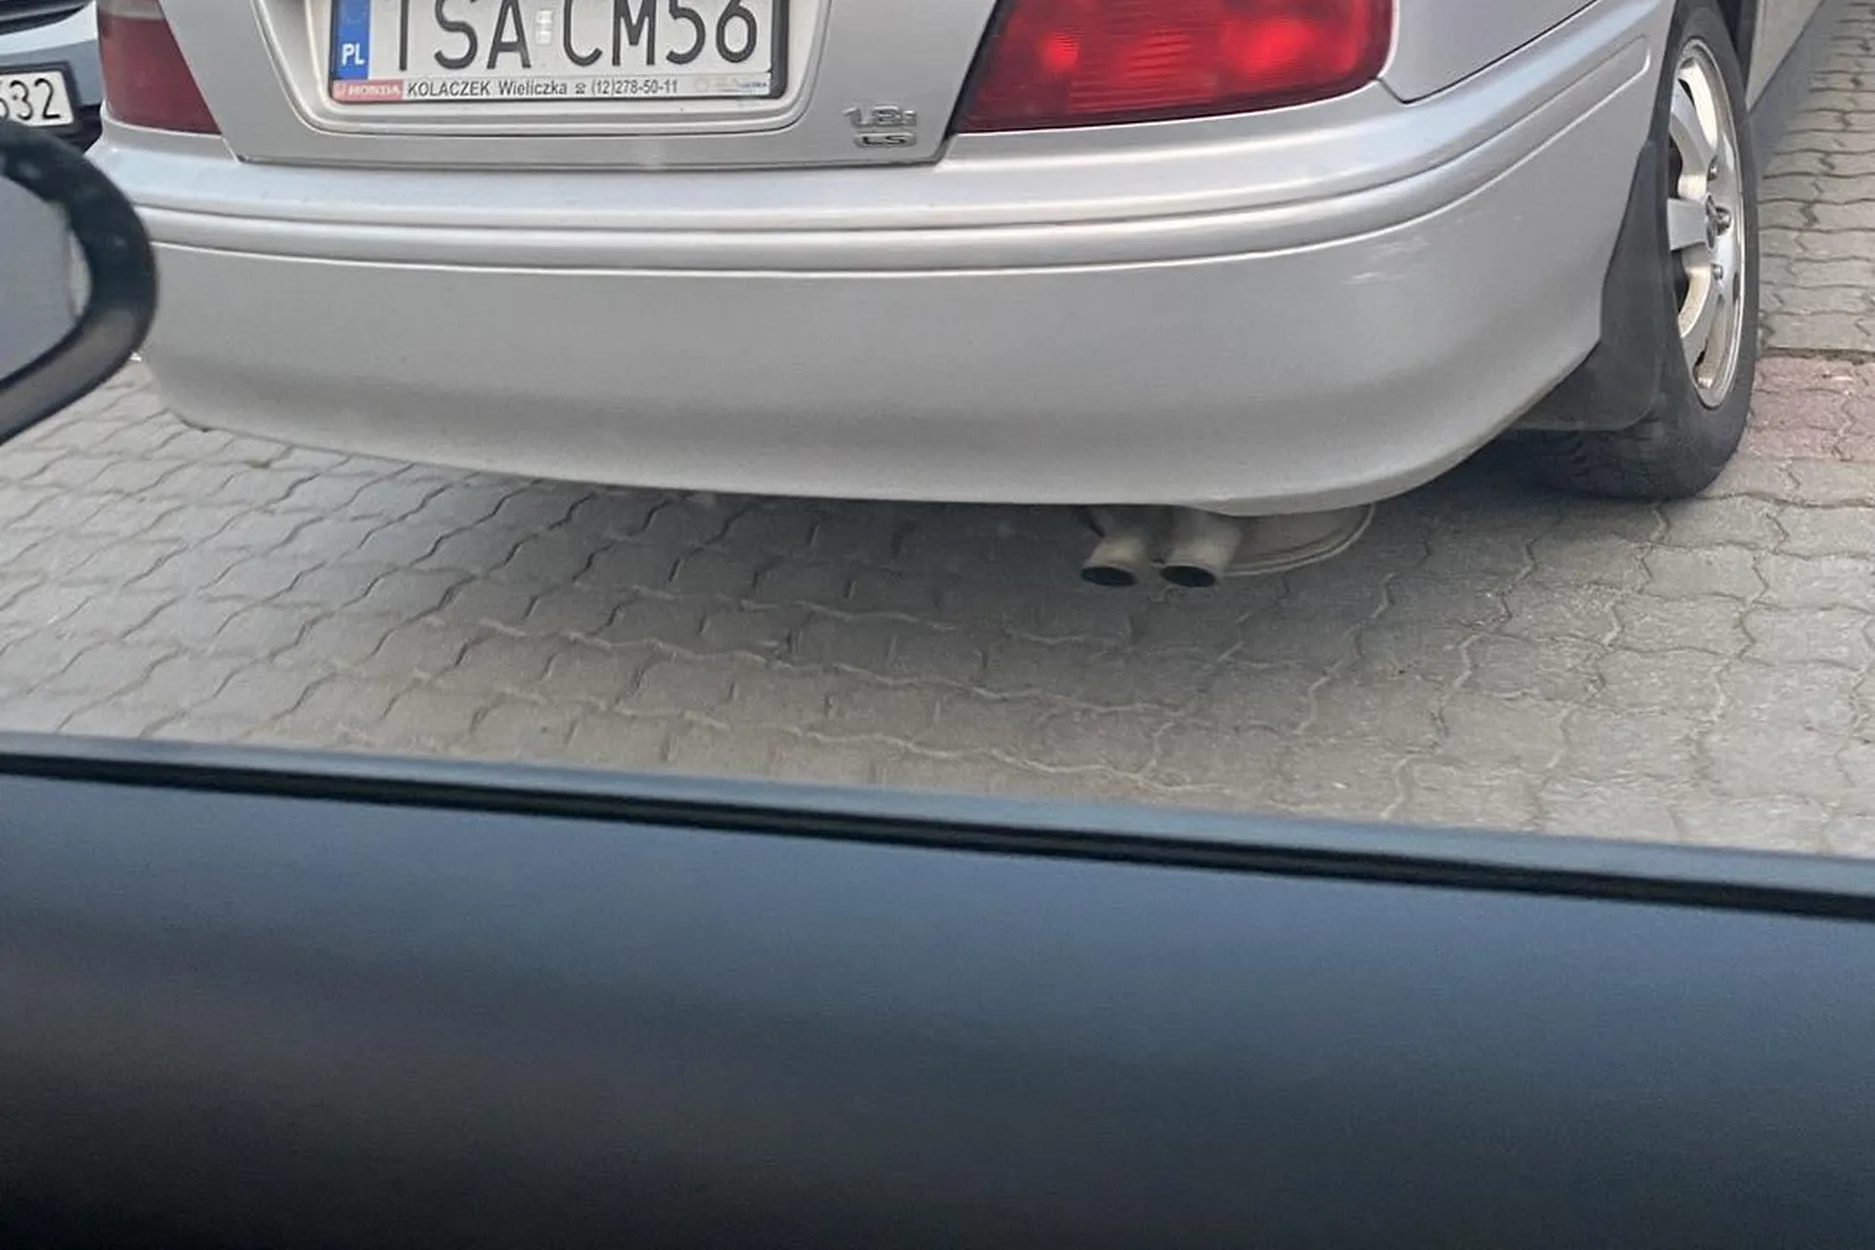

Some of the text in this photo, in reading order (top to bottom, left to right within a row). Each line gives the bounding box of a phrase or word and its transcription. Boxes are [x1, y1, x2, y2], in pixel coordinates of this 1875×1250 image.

[341, 44, 365, 65] PL
[349, 82, 400, 96] HONDA
[499, 77, 567, 96] Wieliczka
[591, 79, 678, 96] (12)278-50-11
